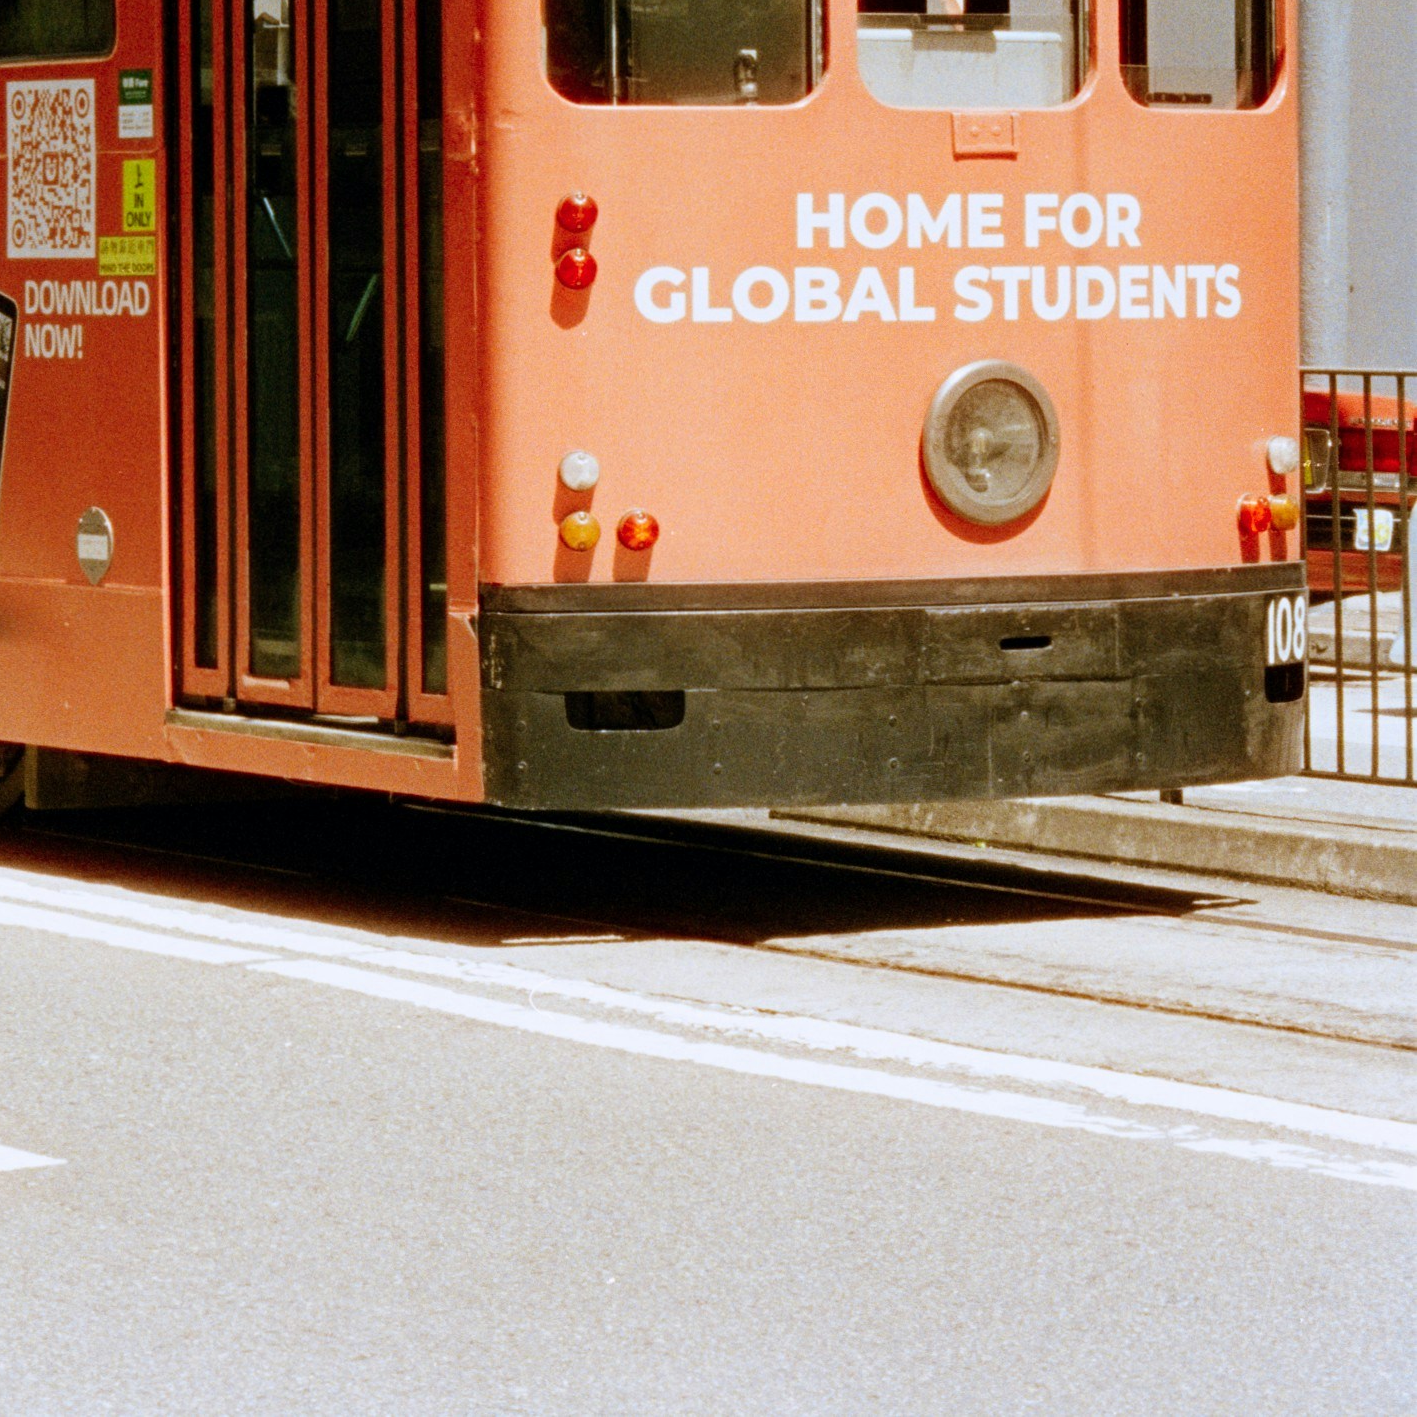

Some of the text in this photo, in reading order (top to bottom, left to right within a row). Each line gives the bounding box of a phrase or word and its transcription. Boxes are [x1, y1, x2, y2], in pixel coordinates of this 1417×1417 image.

[133, 193, 144, 209] IN
[126, 211, 152, 228] ONLY
[797, 192, 1141, 249] HOME FOR
[118, 262, 131, 273] THE
[25, 280, 150, 316] DOWNLOAD
[634, 263, 1241, 323] GLOBAL STUDENTS
[25, 323, 83, 359] NOW!
[1267, 595, 1306, 665] 108
